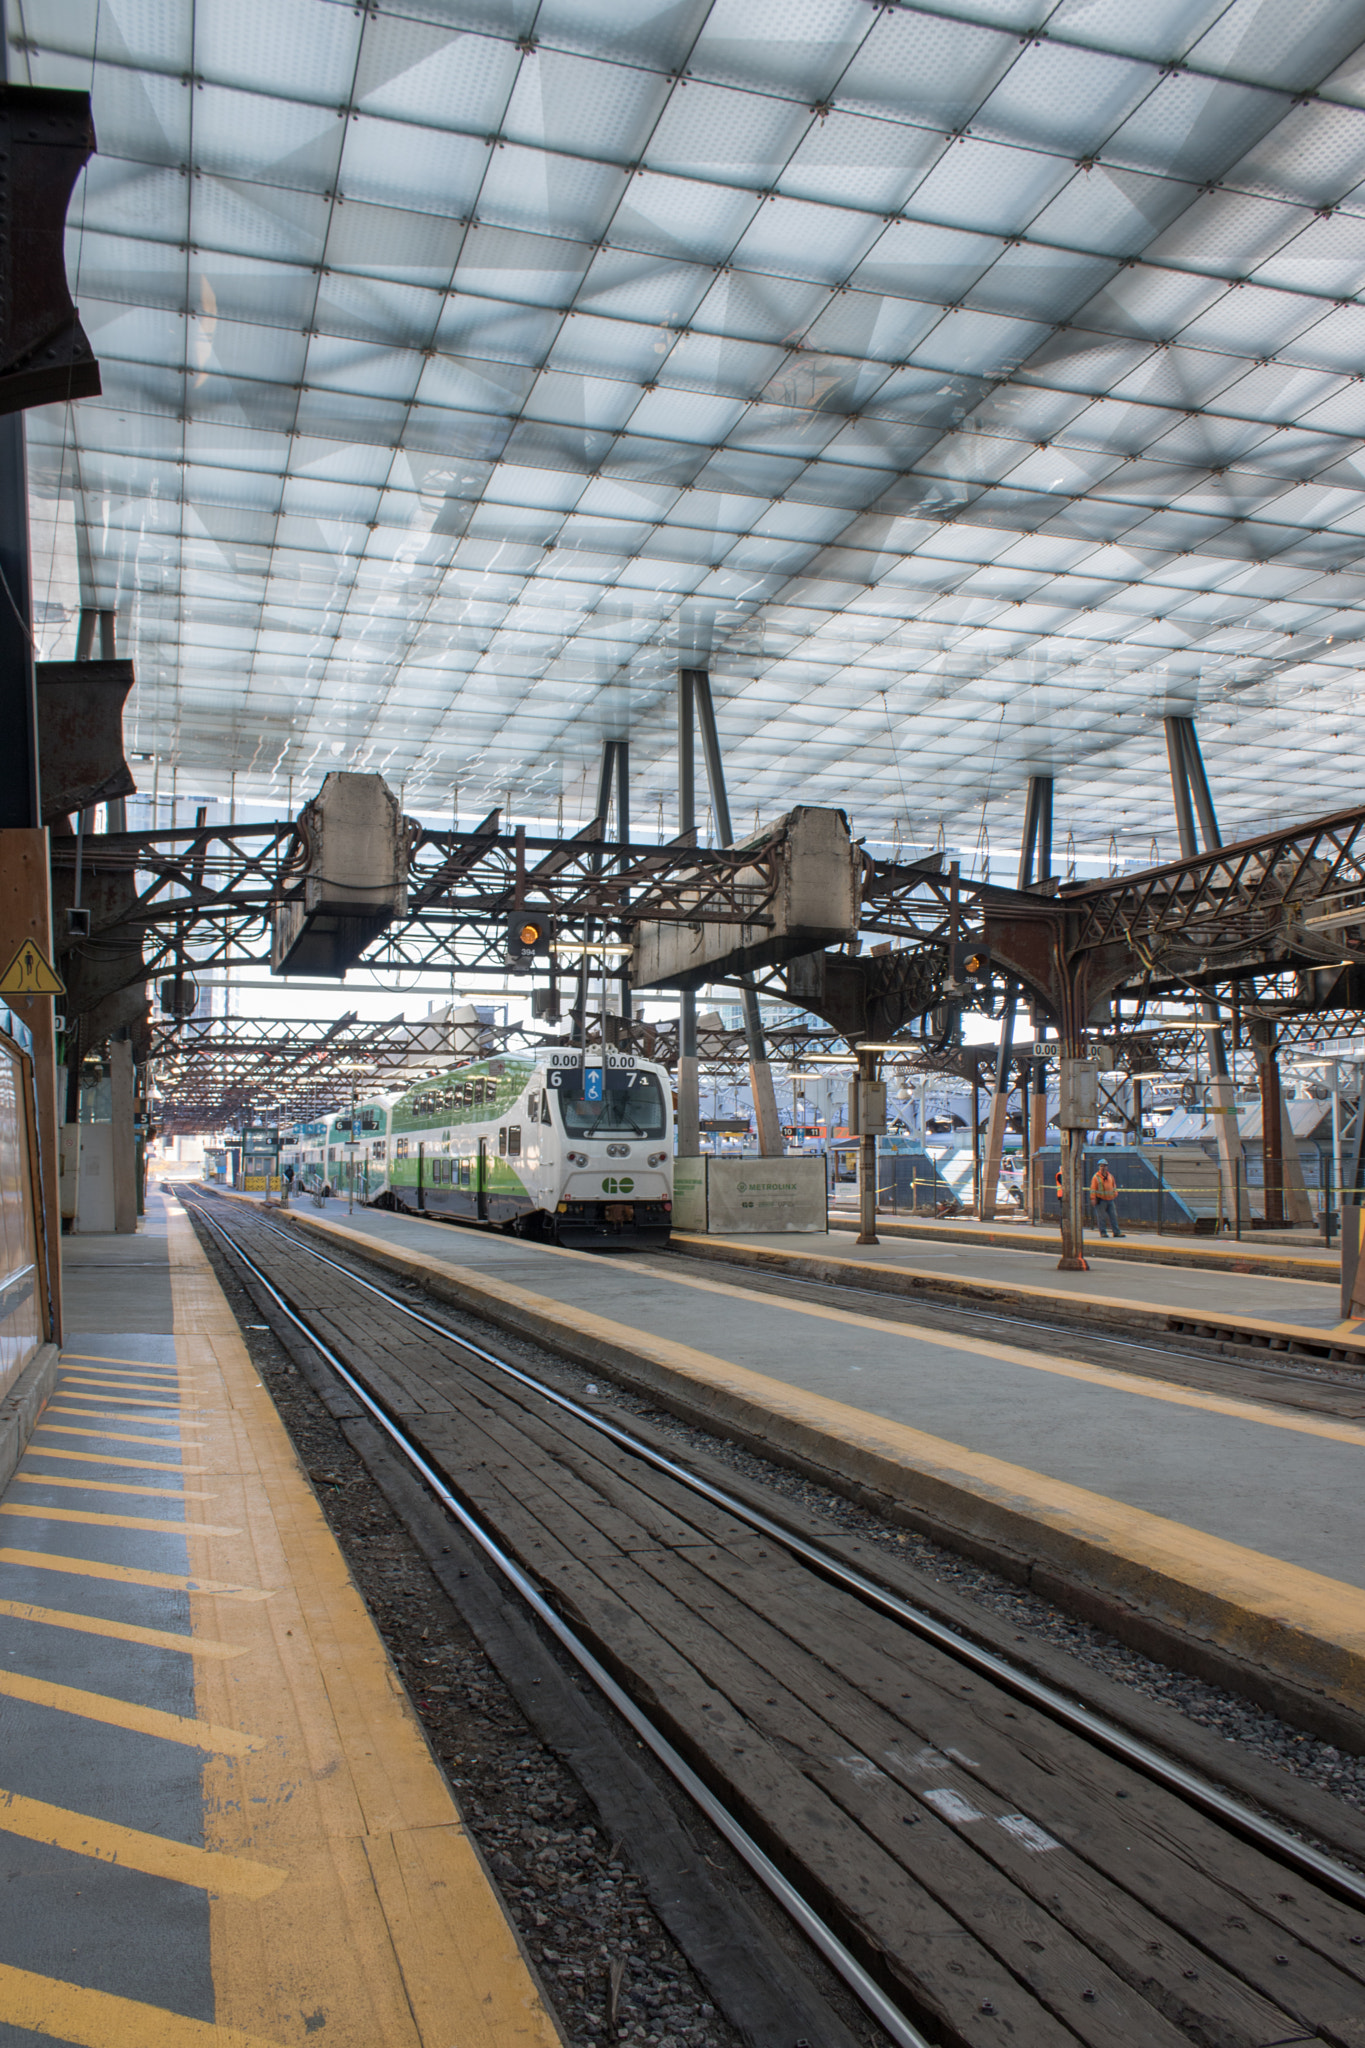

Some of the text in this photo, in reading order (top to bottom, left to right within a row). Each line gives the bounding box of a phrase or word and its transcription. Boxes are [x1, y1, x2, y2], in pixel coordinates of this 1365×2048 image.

[1035, 1044, 1057, 1055] 0.00
[552, 1055, 578, 1067] 0.00
[609, 1056, 635, 1068] 0.00
[550, 1071, 638, 1088] 6 7
[140, 1114, 148, 1123] 5
[336, 1121, 378, 1129] 6 7
[602, 1177, 634, 1194] GO
[749, 1183, 797, 1191] METROLINX
